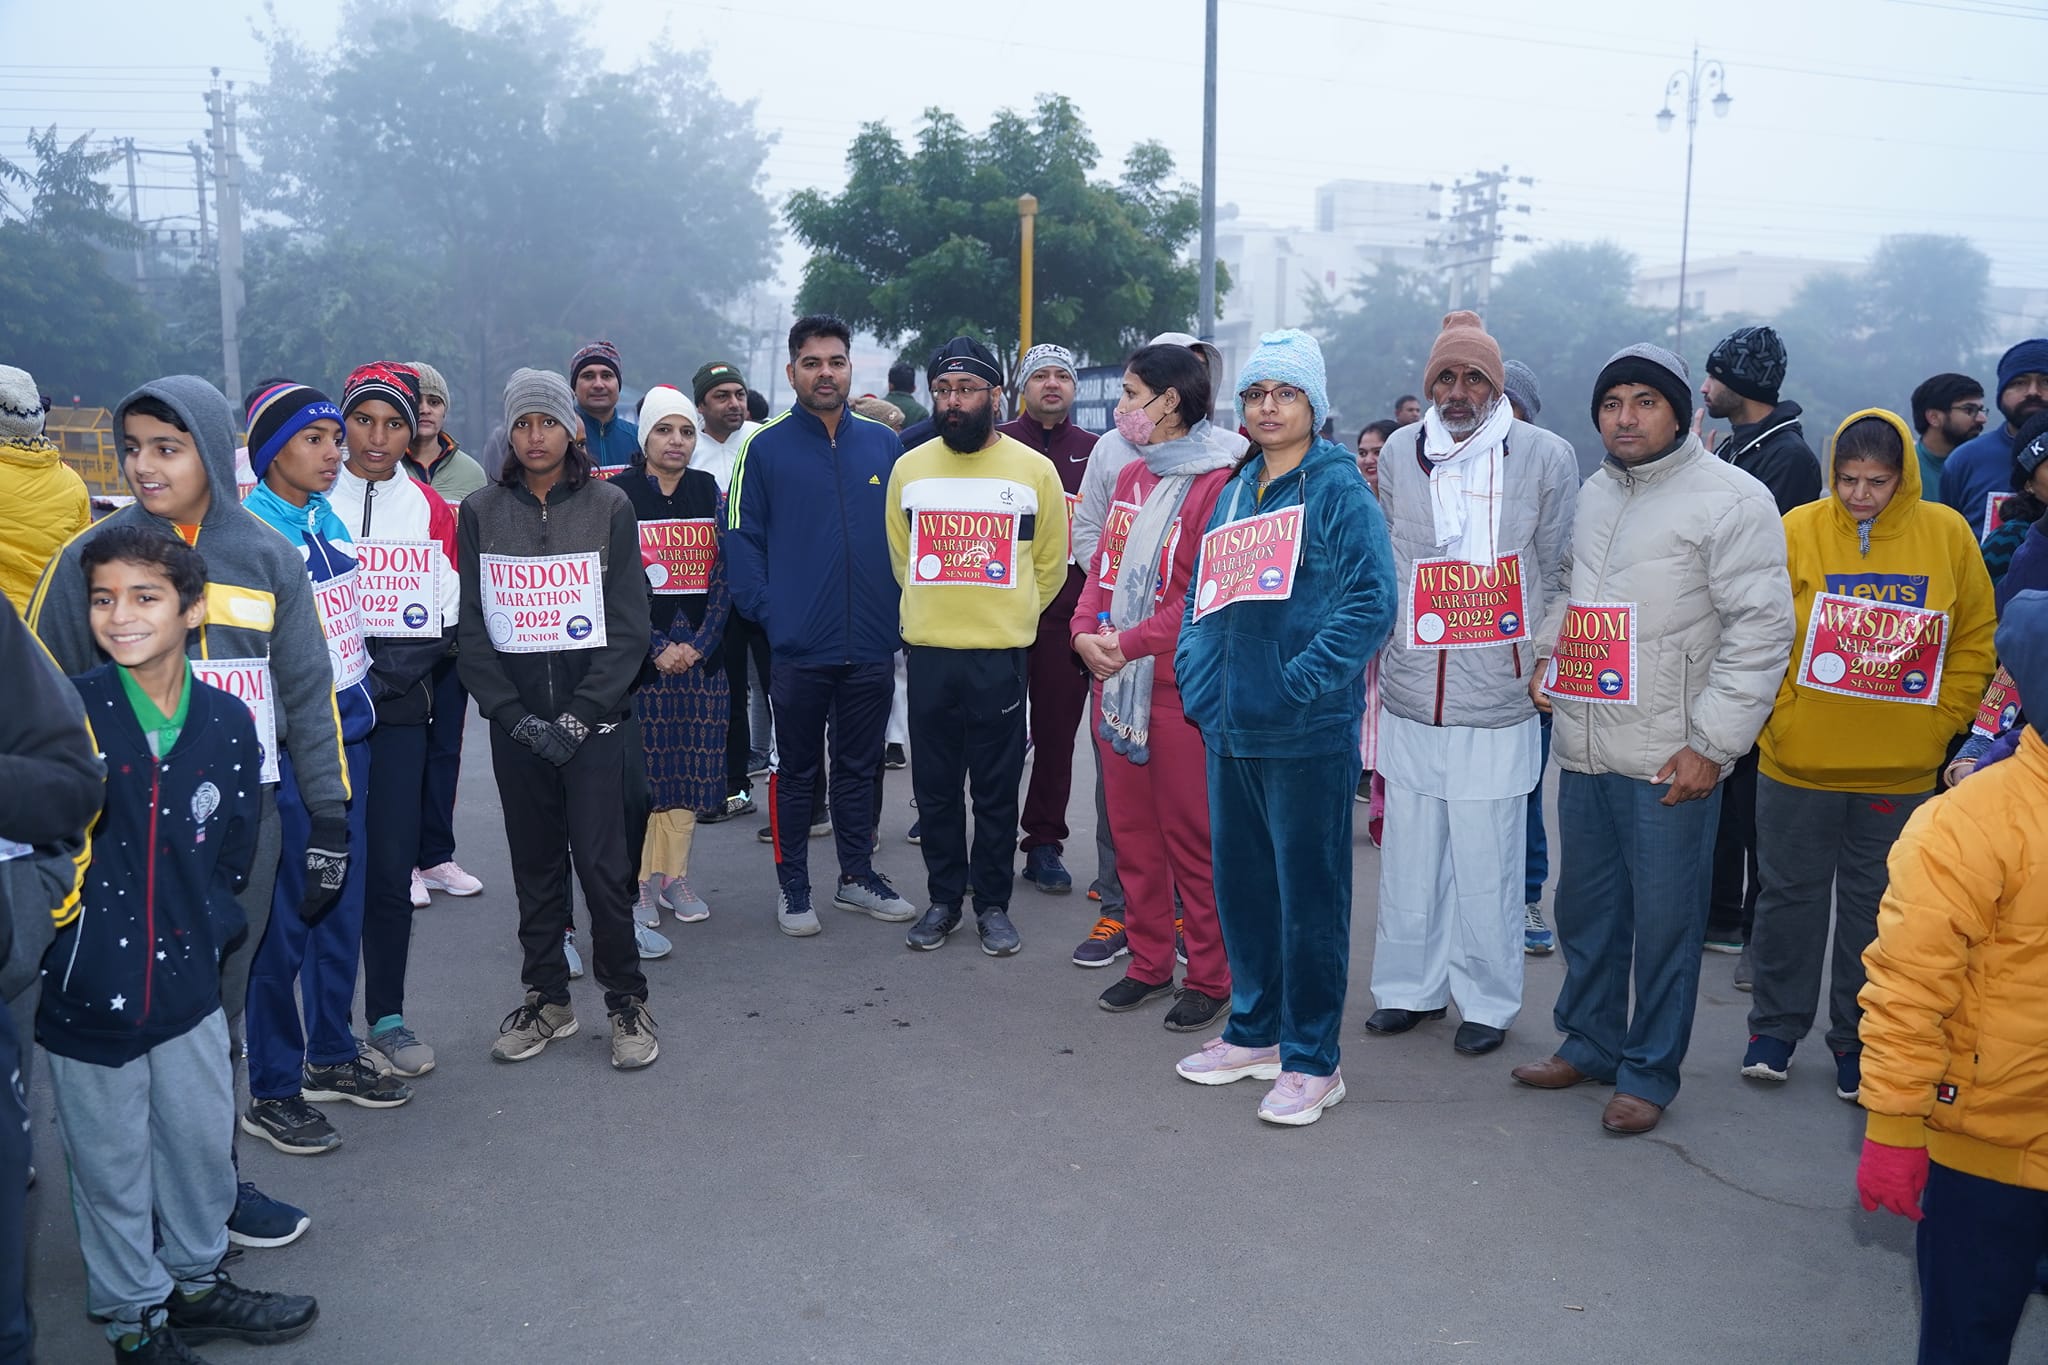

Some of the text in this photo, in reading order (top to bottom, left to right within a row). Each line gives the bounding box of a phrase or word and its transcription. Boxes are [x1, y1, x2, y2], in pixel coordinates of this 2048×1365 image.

[920, 514, 1012, 540] WISDOM
[932, 539, 998, 552] MARATHON
[1207, 515, 1296, 561] WISDOM
[356, 546, 431, 573] SDOM
[671, 562, 706, 576] 2022
[943, 552, 983, 568] 2022
[357, 575, 420, 590] RATHON
[489, 560, 591, 589] WISDOM
[673, 579, 706, 587] SENIOR
[945, 570, 981, 579] SENIOR
[1420, 560, 1519, 592] WISDOM
[361, 593, 399, 612] 022
[496, 590, 581, 606] MARATHON
[1431, 590, 1508, 609] MARATHON
[514, 609, 561, 628] 2022
[1447, 609, 1495, 628] 2022
[1825, 602, 1944, 645] WISDOM
[517, 632, 559, 642] JUNIOR
[1452, 630, 1494, 640] SENIOR
[1559, 658, 1594, 680] 2022
[1850, 657, 1903, 681] 2022
[194, 669, 265, 701] DOM
[1561, 680, 1594, 693] SENIOR
[1850, 678, 1897, 693] SENIOR
